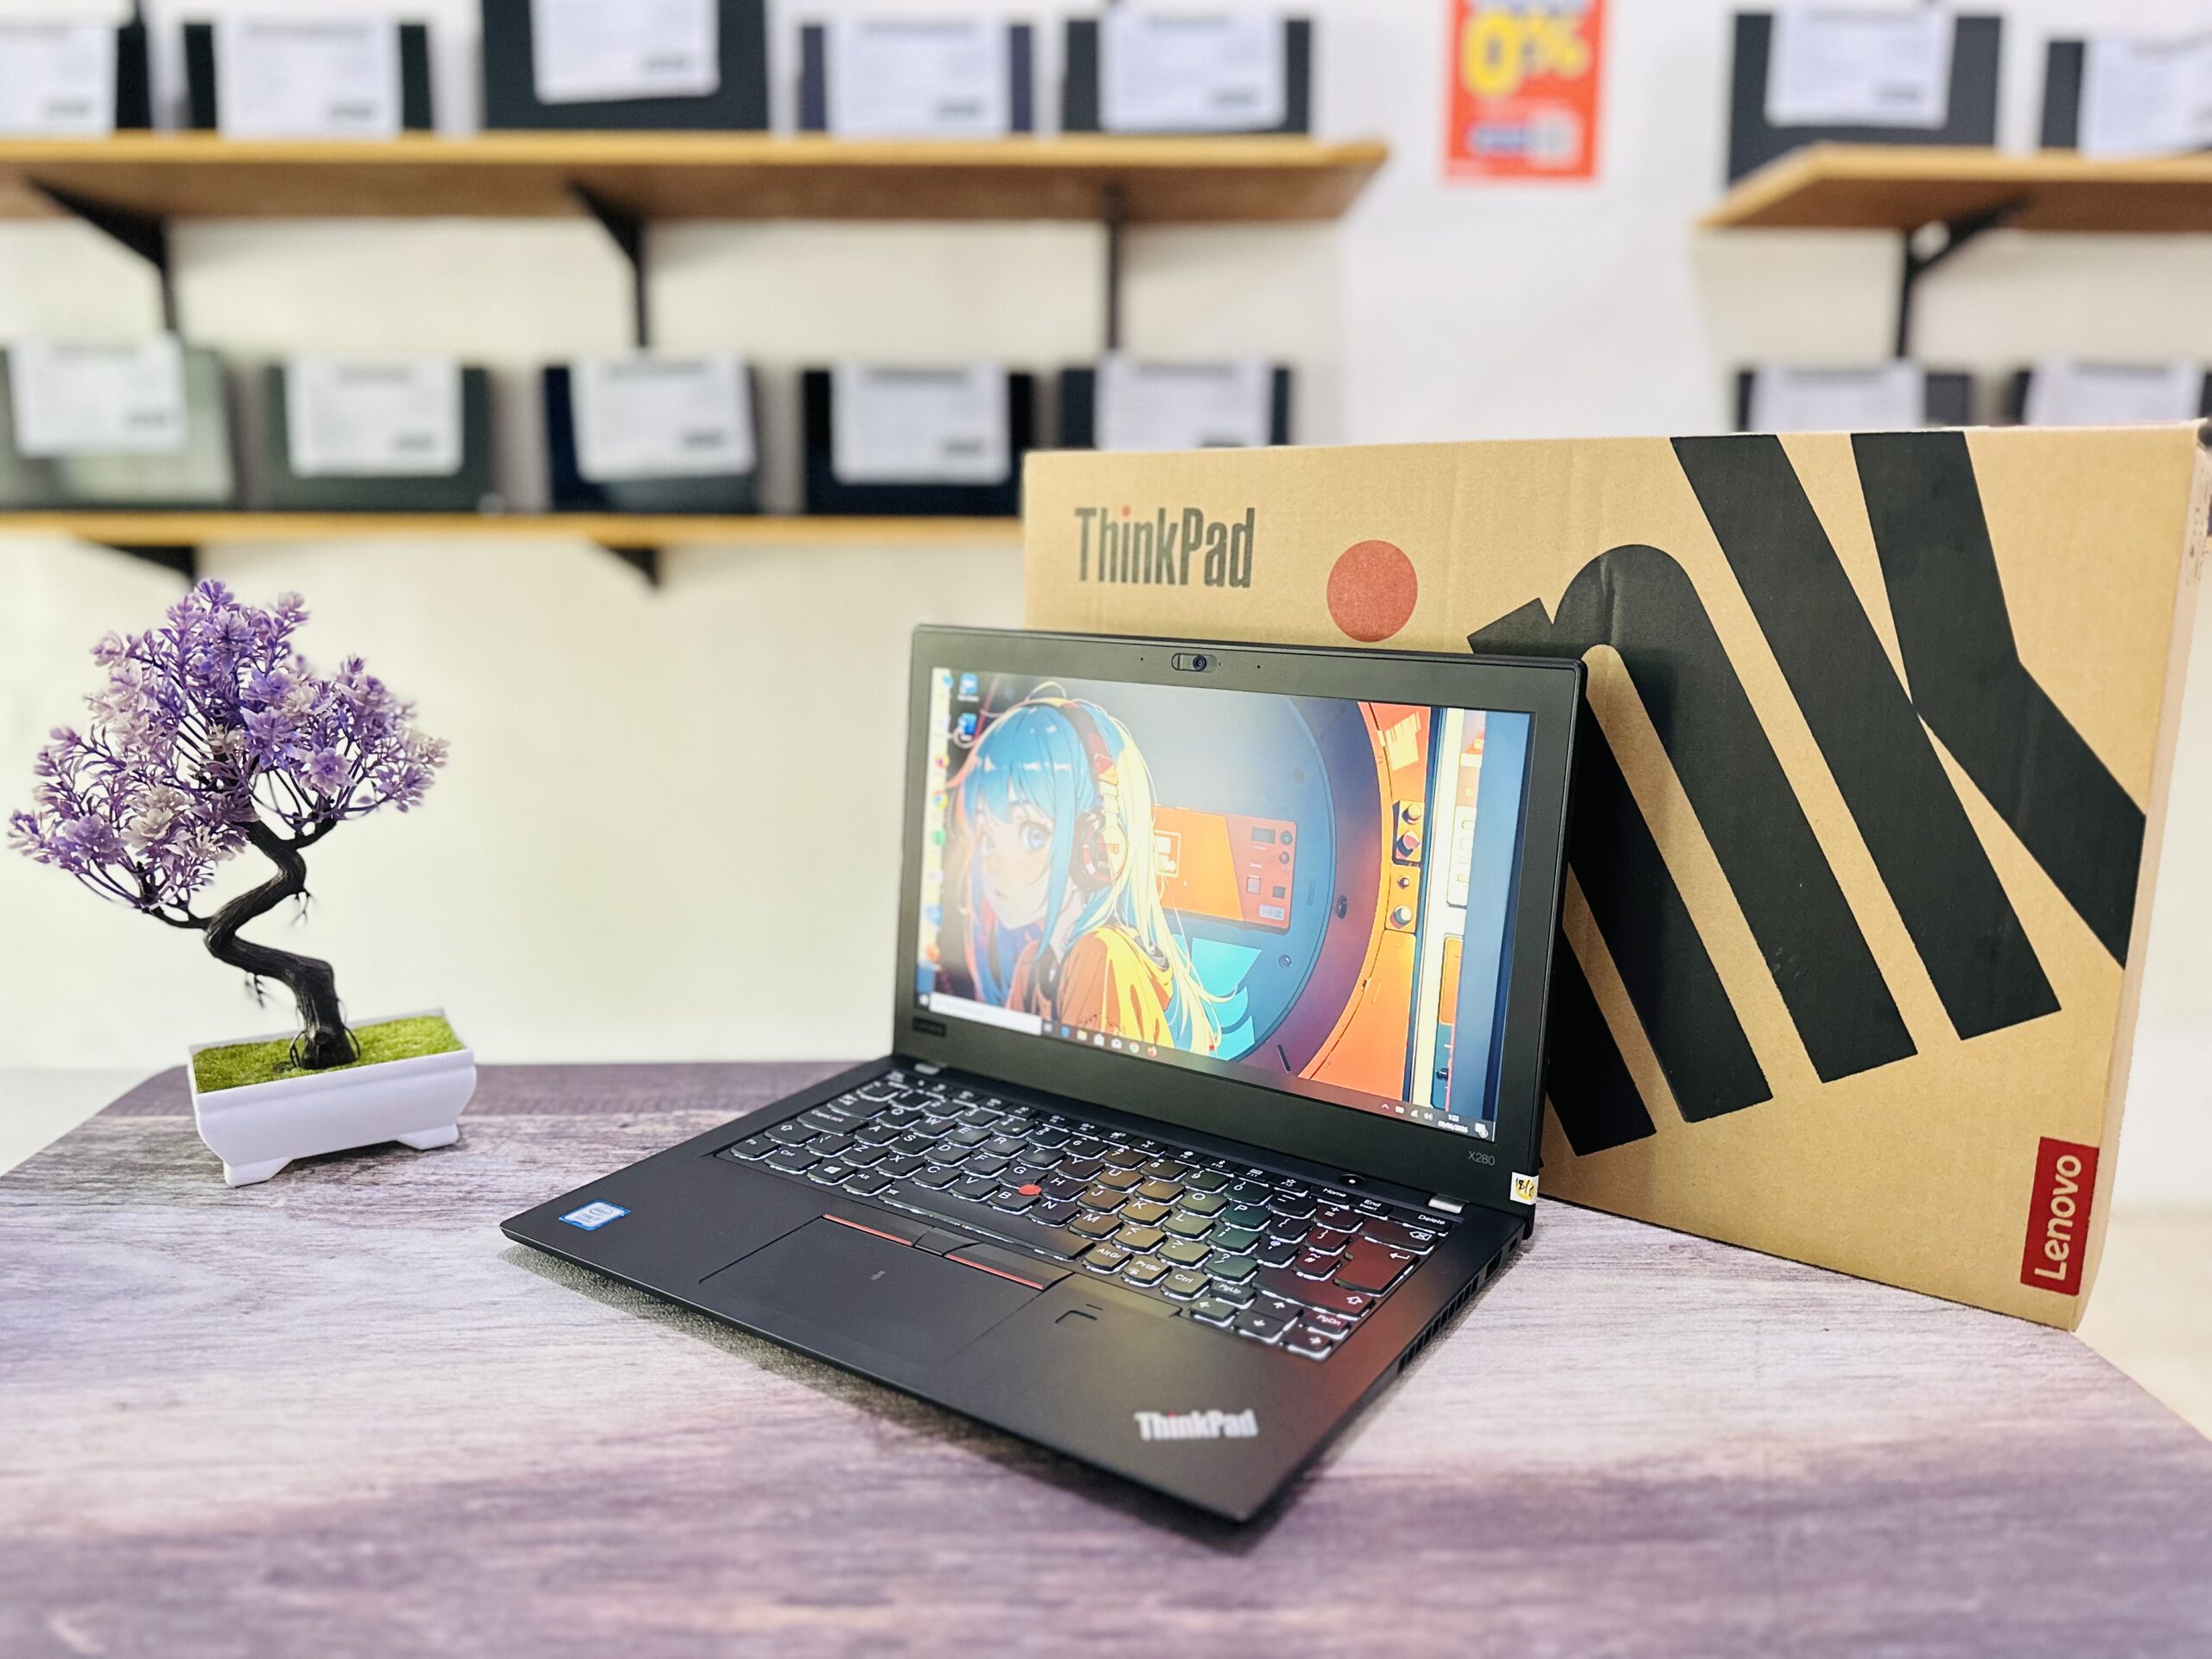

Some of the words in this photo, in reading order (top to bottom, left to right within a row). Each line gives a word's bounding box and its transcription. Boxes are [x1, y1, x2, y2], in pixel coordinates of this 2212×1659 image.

[1074, 506, 1255, 588] ThinkPad
[994, 1136, 1007, 1145] R
[1467, 1151, 1496, 1166] X280
[965, 1176, 979, 1185] V
[1050, 1177, 1065, 1186] H
[997, 1191, 1012, 1199] B
[1322, 1187, 1347, 1198] Home
[1041, 1200, 1058, 1210] N
[1132, 1198, 1147, 1210] K
[1363, 1198, 1382, 1208] End
[1083, 1213, 1101, 1223] M
[1174, 1213, 1185, 1222] L
[1418, 1214, 1446, 1225] Delete
[2034, 1154, 2082, 1281] Lenovo
[1096, 1248, 1122, 1259] AltGr
[1135, 1260, 1161, 1272] PrtSc
[1174, 1274, 1194, 1284] Ctrl
[1218, 1283, 1242, 1294] PgUp
[1316, 1314, 1341, 1325] PgDn
[1133, 1408, 1260, 1441] ThinkPad
